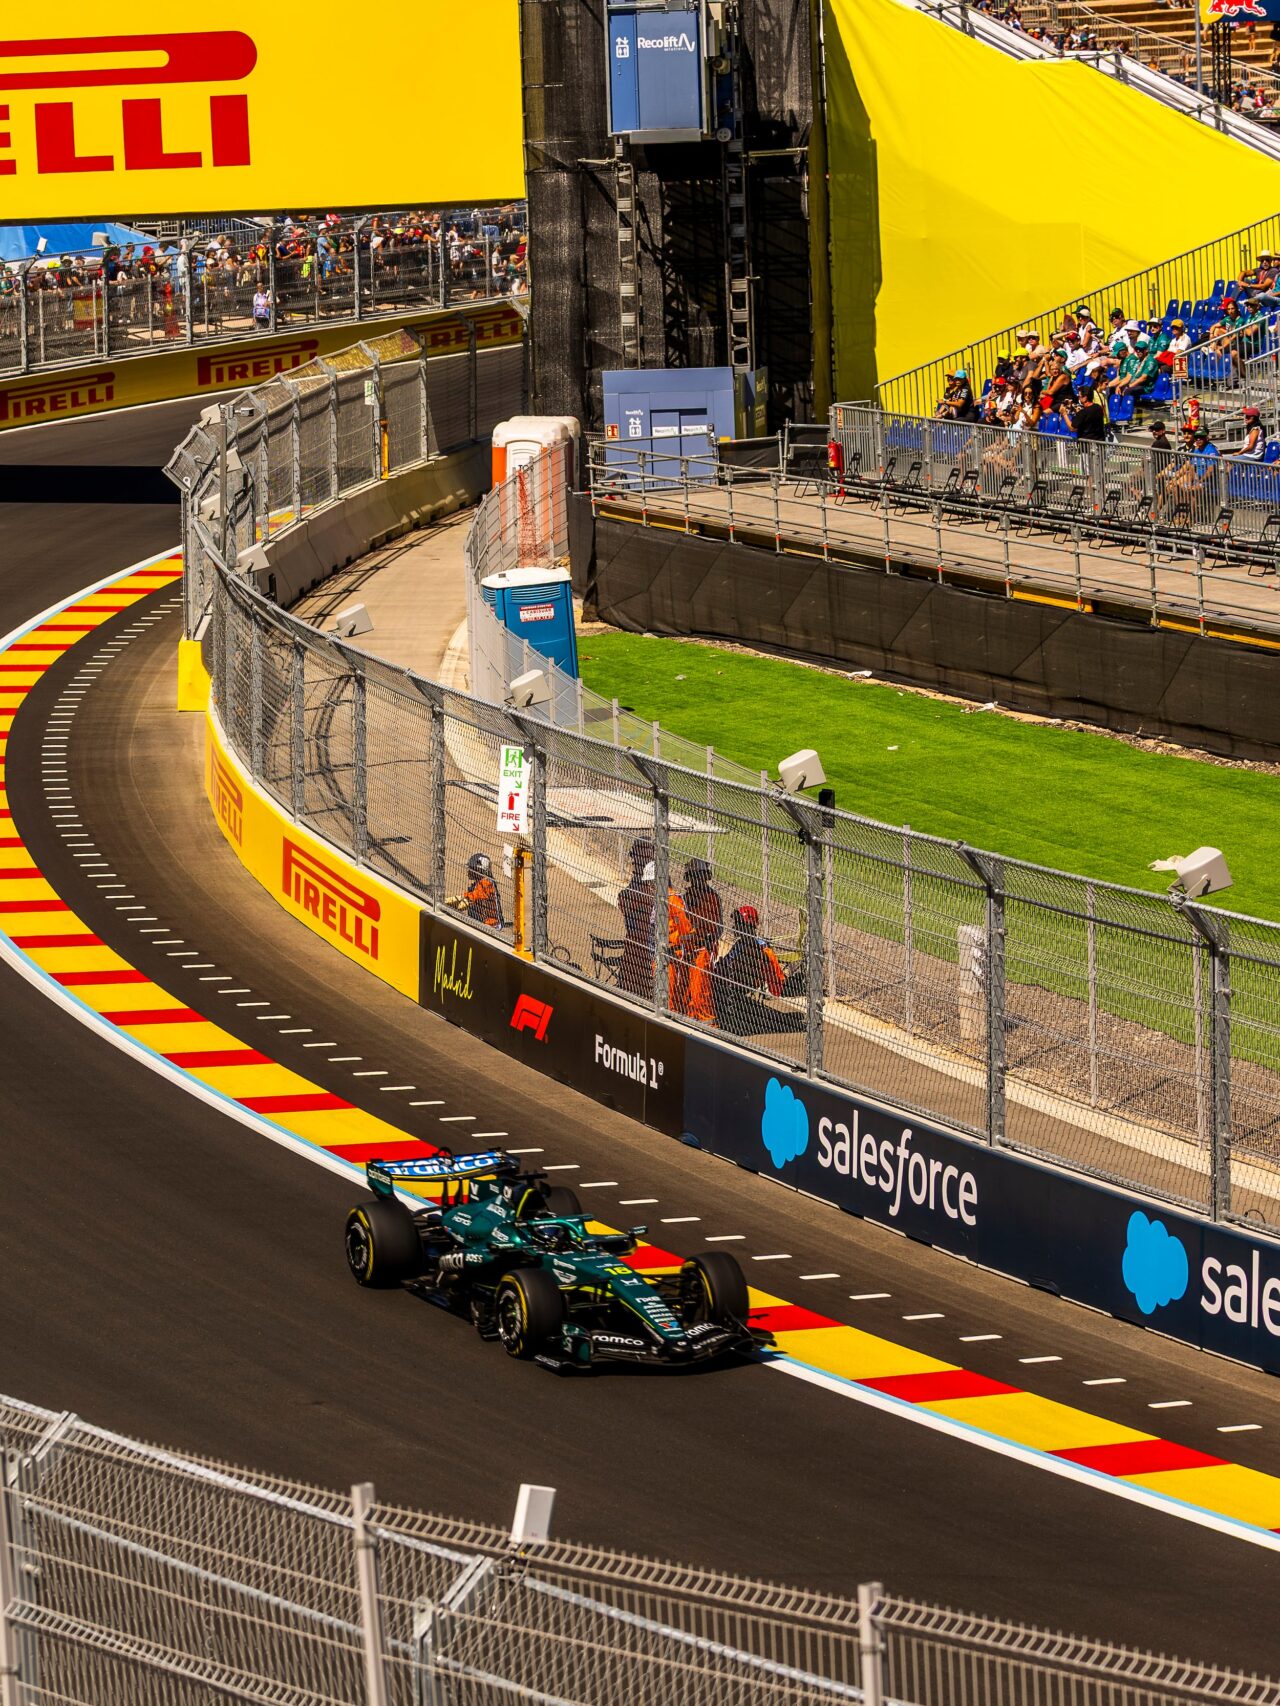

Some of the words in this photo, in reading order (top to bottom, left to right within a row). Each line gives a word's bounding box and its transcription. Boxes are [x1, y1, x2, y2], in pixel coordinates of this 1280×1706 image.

[637, 35, 679, 49] Recolift
[403, 309, 519, 350] PRELLI
[210, 744, 244, 848] PIRELLI
[503, 769, 523, 778] EXIT
[501, 812, 521, 821] FIRE
[282, 835, 381, 961] PIRELLI
[433, 939, 475, 1005] Madrid
[595, 1034, 648, 1086] Formula
[817, 1109, 978, 1226] salesforce
[603, 1266, 633, 1275] 18
[1200, 1249, 1280, 1337] sale
